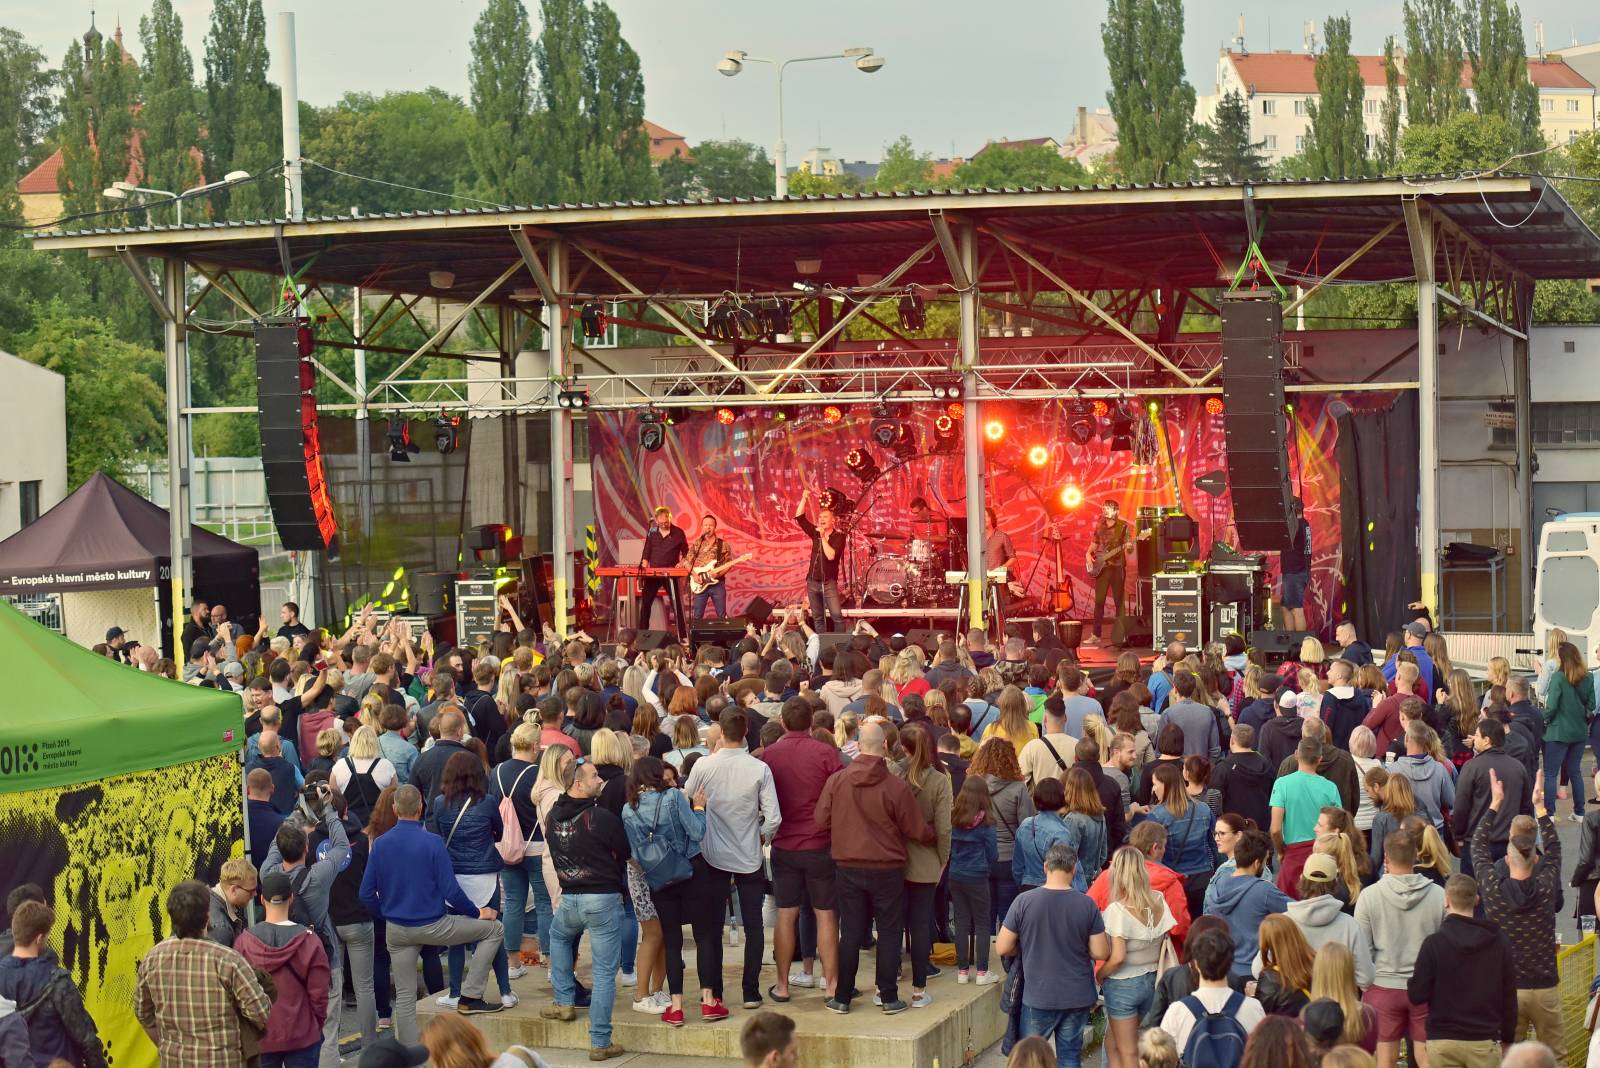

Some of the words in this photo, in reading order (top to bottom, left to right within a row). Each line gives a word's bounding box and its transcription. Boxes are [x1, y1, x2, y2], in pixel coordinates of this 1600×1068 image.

[12, 574, 54, 586] Evropské
[56, 573, 84, 583] hlavní
[86, 571, 115, 582] město
[117, 570, 150, 580] kultury
